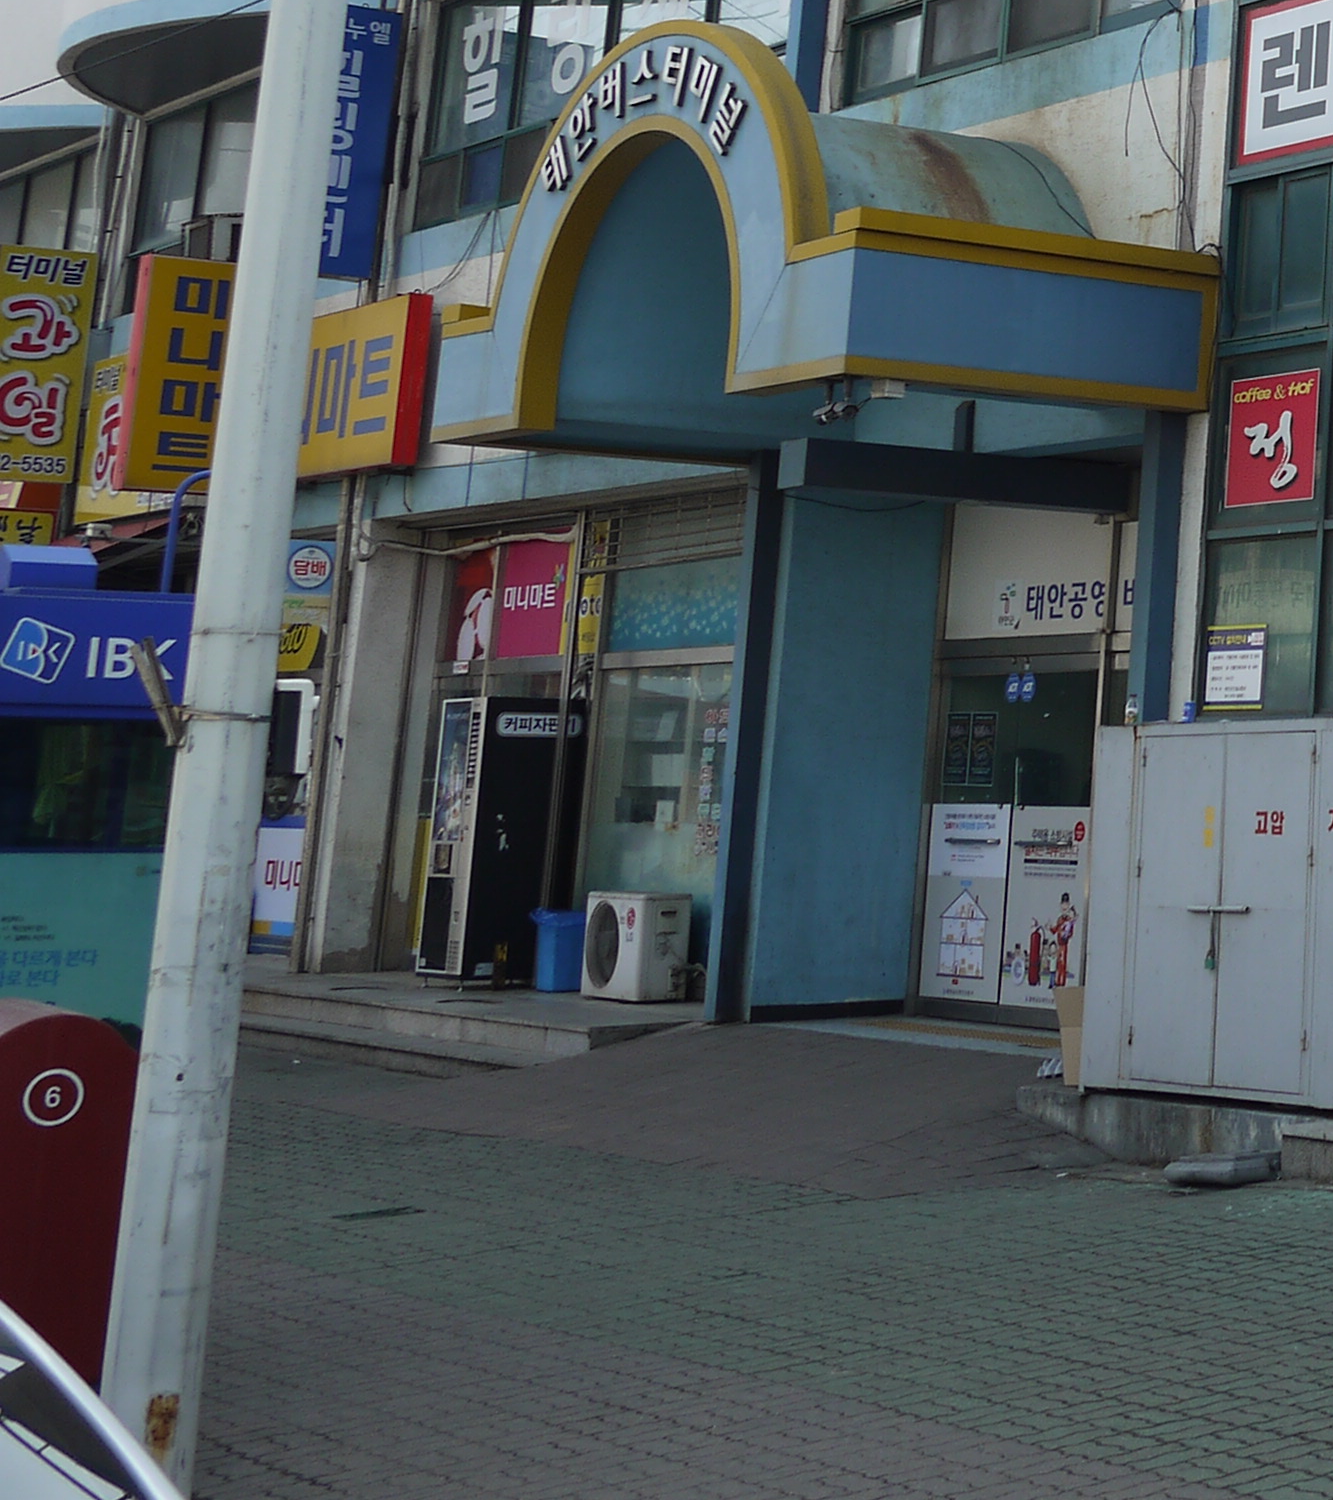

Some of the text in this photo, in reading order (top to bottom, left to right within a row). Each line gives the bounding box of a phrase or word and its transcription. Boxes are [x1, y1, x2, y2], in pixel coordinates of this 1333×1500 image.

[540, 44, 748, 193] 태안버스터미널
[5, 253, 88, 286] 터미널
[302, 335, 395, 445] 마트
[1234, 389, 1271, 404] coffee
[1274, 384, 1286, 400] &
[293, 559, 328, 577] 담배
[502, 582, 557, 611] 미니마트
[1254, 810, 1285, 835] 고압
[44, 1085, 62, 1108] 6
